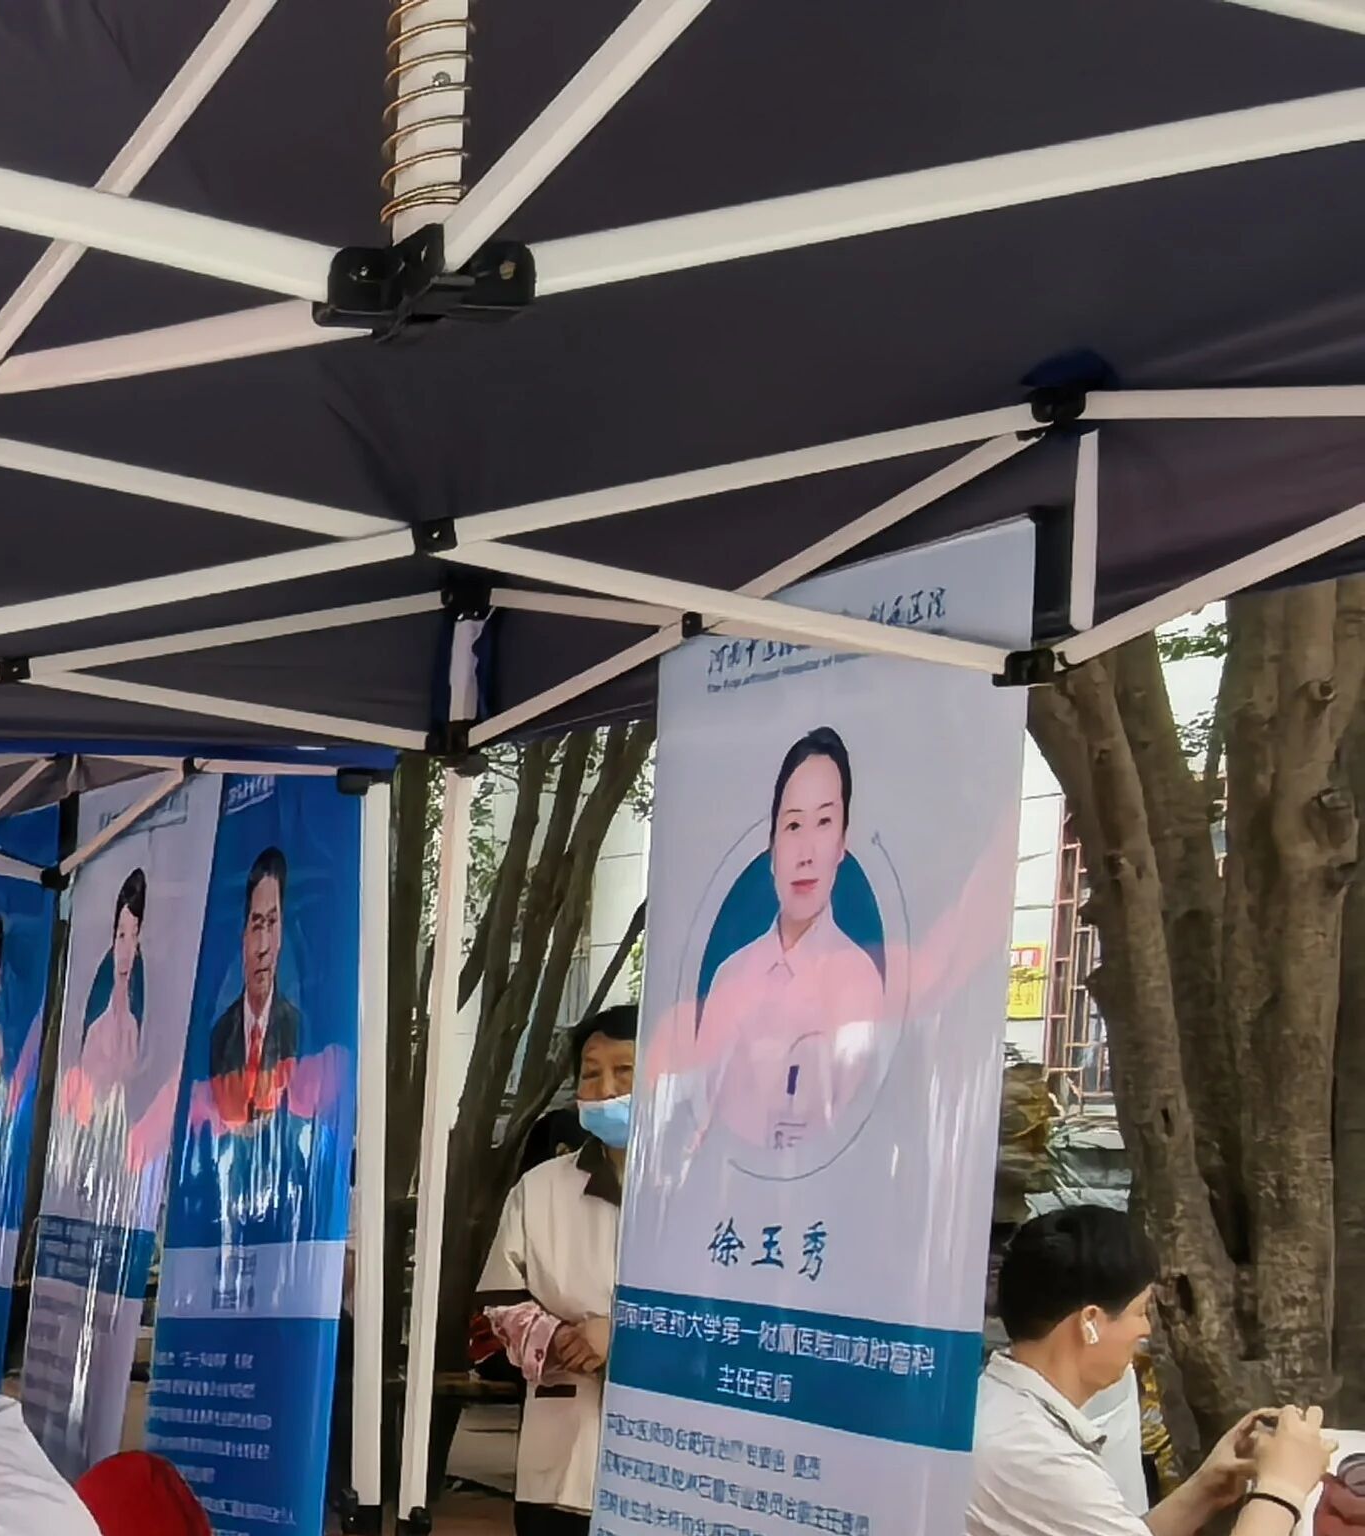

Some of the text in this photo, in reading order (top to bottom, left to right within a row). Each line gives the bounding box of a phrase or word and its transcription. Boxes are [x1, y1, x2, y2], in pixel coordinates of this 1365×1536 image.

[707, 1216, 827, 1282] 徐玉秀
[716, 1363, 794, 1404] 主任医师
